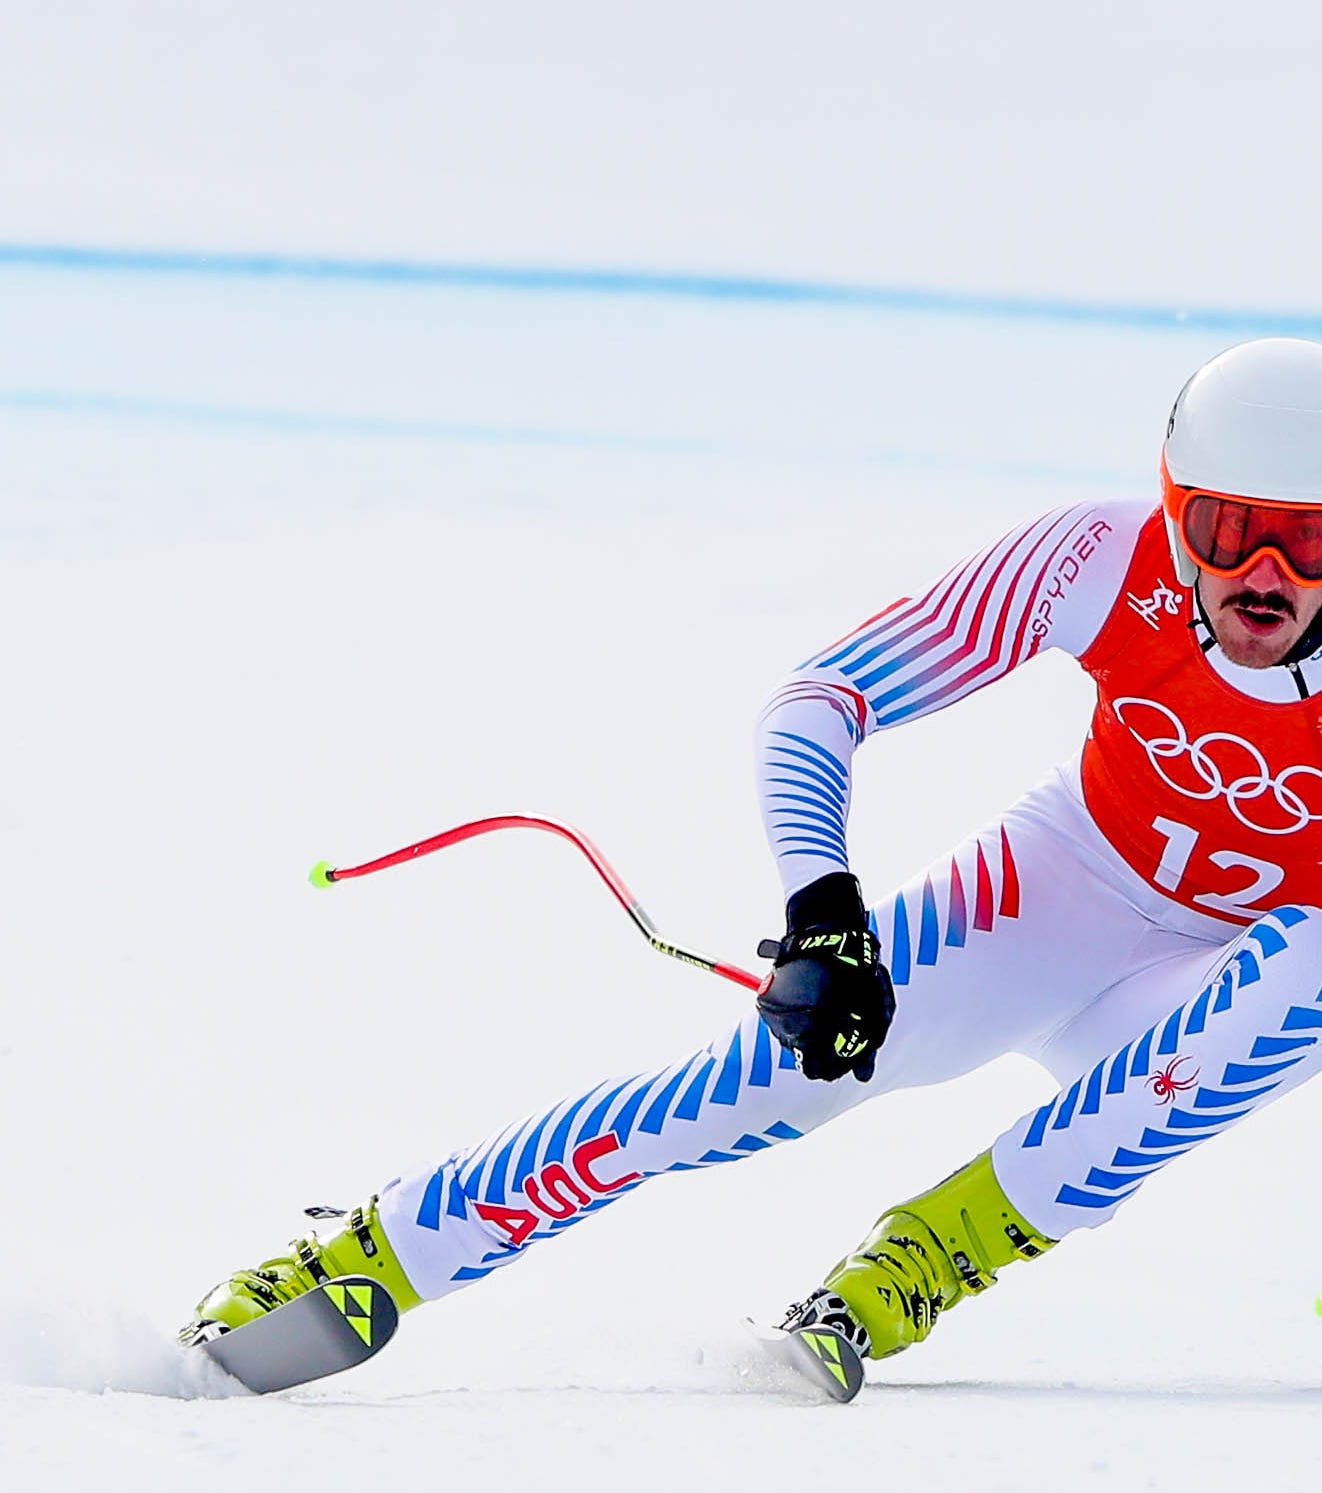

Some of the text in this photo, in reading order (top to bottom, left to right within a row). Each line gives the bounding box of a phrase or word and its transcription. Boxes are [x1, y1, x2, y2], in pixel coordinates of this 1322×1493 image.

[1031, 520, 1113, 638] SPYDER
[1152, 815, 1285, 920] 12
[473, 1132, 643, 1246] USA
